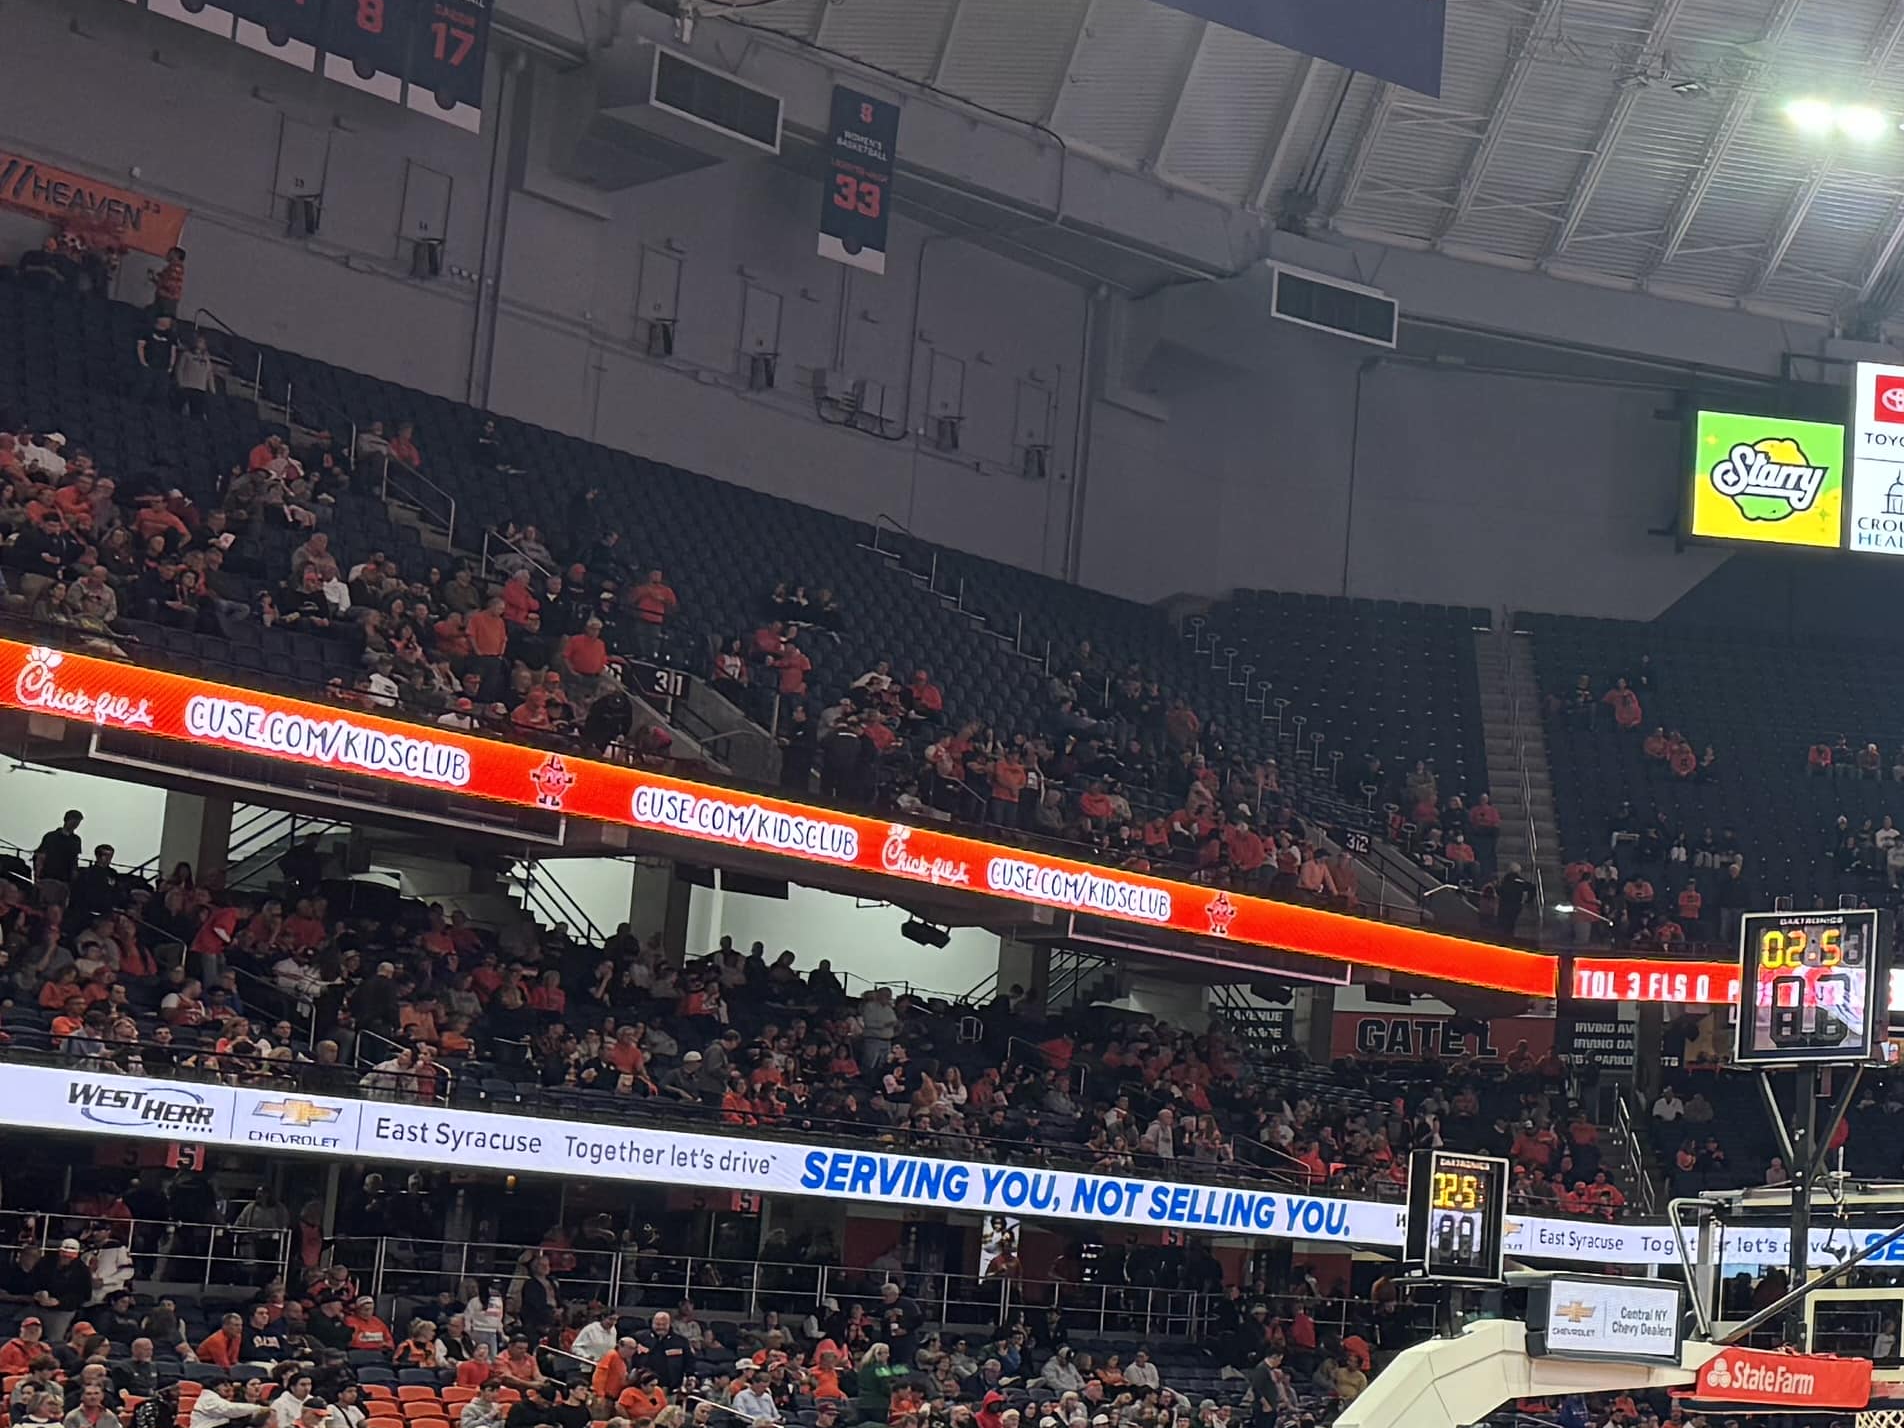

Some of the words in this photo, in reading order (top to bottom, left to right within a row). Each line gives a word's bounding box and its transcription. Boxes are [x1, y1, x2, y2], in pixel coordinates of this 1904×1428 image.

[431, 22, 475, 68] 17
[33, 180, 144, 232] HEAVEN
[833, 173, 881, 219] 33
[1711, 442, 1829, 512] Starry
[189, 698, 468, 784] CUSE.COM/KIDSCLUB
[634, 785, 857, 860] CUSE.COM/KIDSCLUB
[1346, 829, 1371, 851] 312
[988, 857, 1171, 919] CUSE.COM/KIDSCLUB
[67, 1083, 143, 1112] WEST
[141, 1096, 215, 1126] HERR
[249, 1130, 341, 1149] CHEVROLET
[375, 1117, 430, 1144] East
[434, 1121, 542, 1156] Syracuse
[565, 1135, 665, 1170] Together
[671, 1145, 715, 1174] let's
[801, 1151, 968, 1201] SERVING
[981, 1167, 1060, 1213] YOU,
[1070, 1175, 1135, 1216] NOT
[1148, 1183, 1279, 1233] SELLING
[1285, 1197, 1350, 1238] YOU.
[1612, 1322, 1638, 1338] Chevy
[1642, 1322, 1672, 1338] Dealers
[1620, 1305, 1650, 1322] Central
[1654, 1306, 1669, 1322] NY
